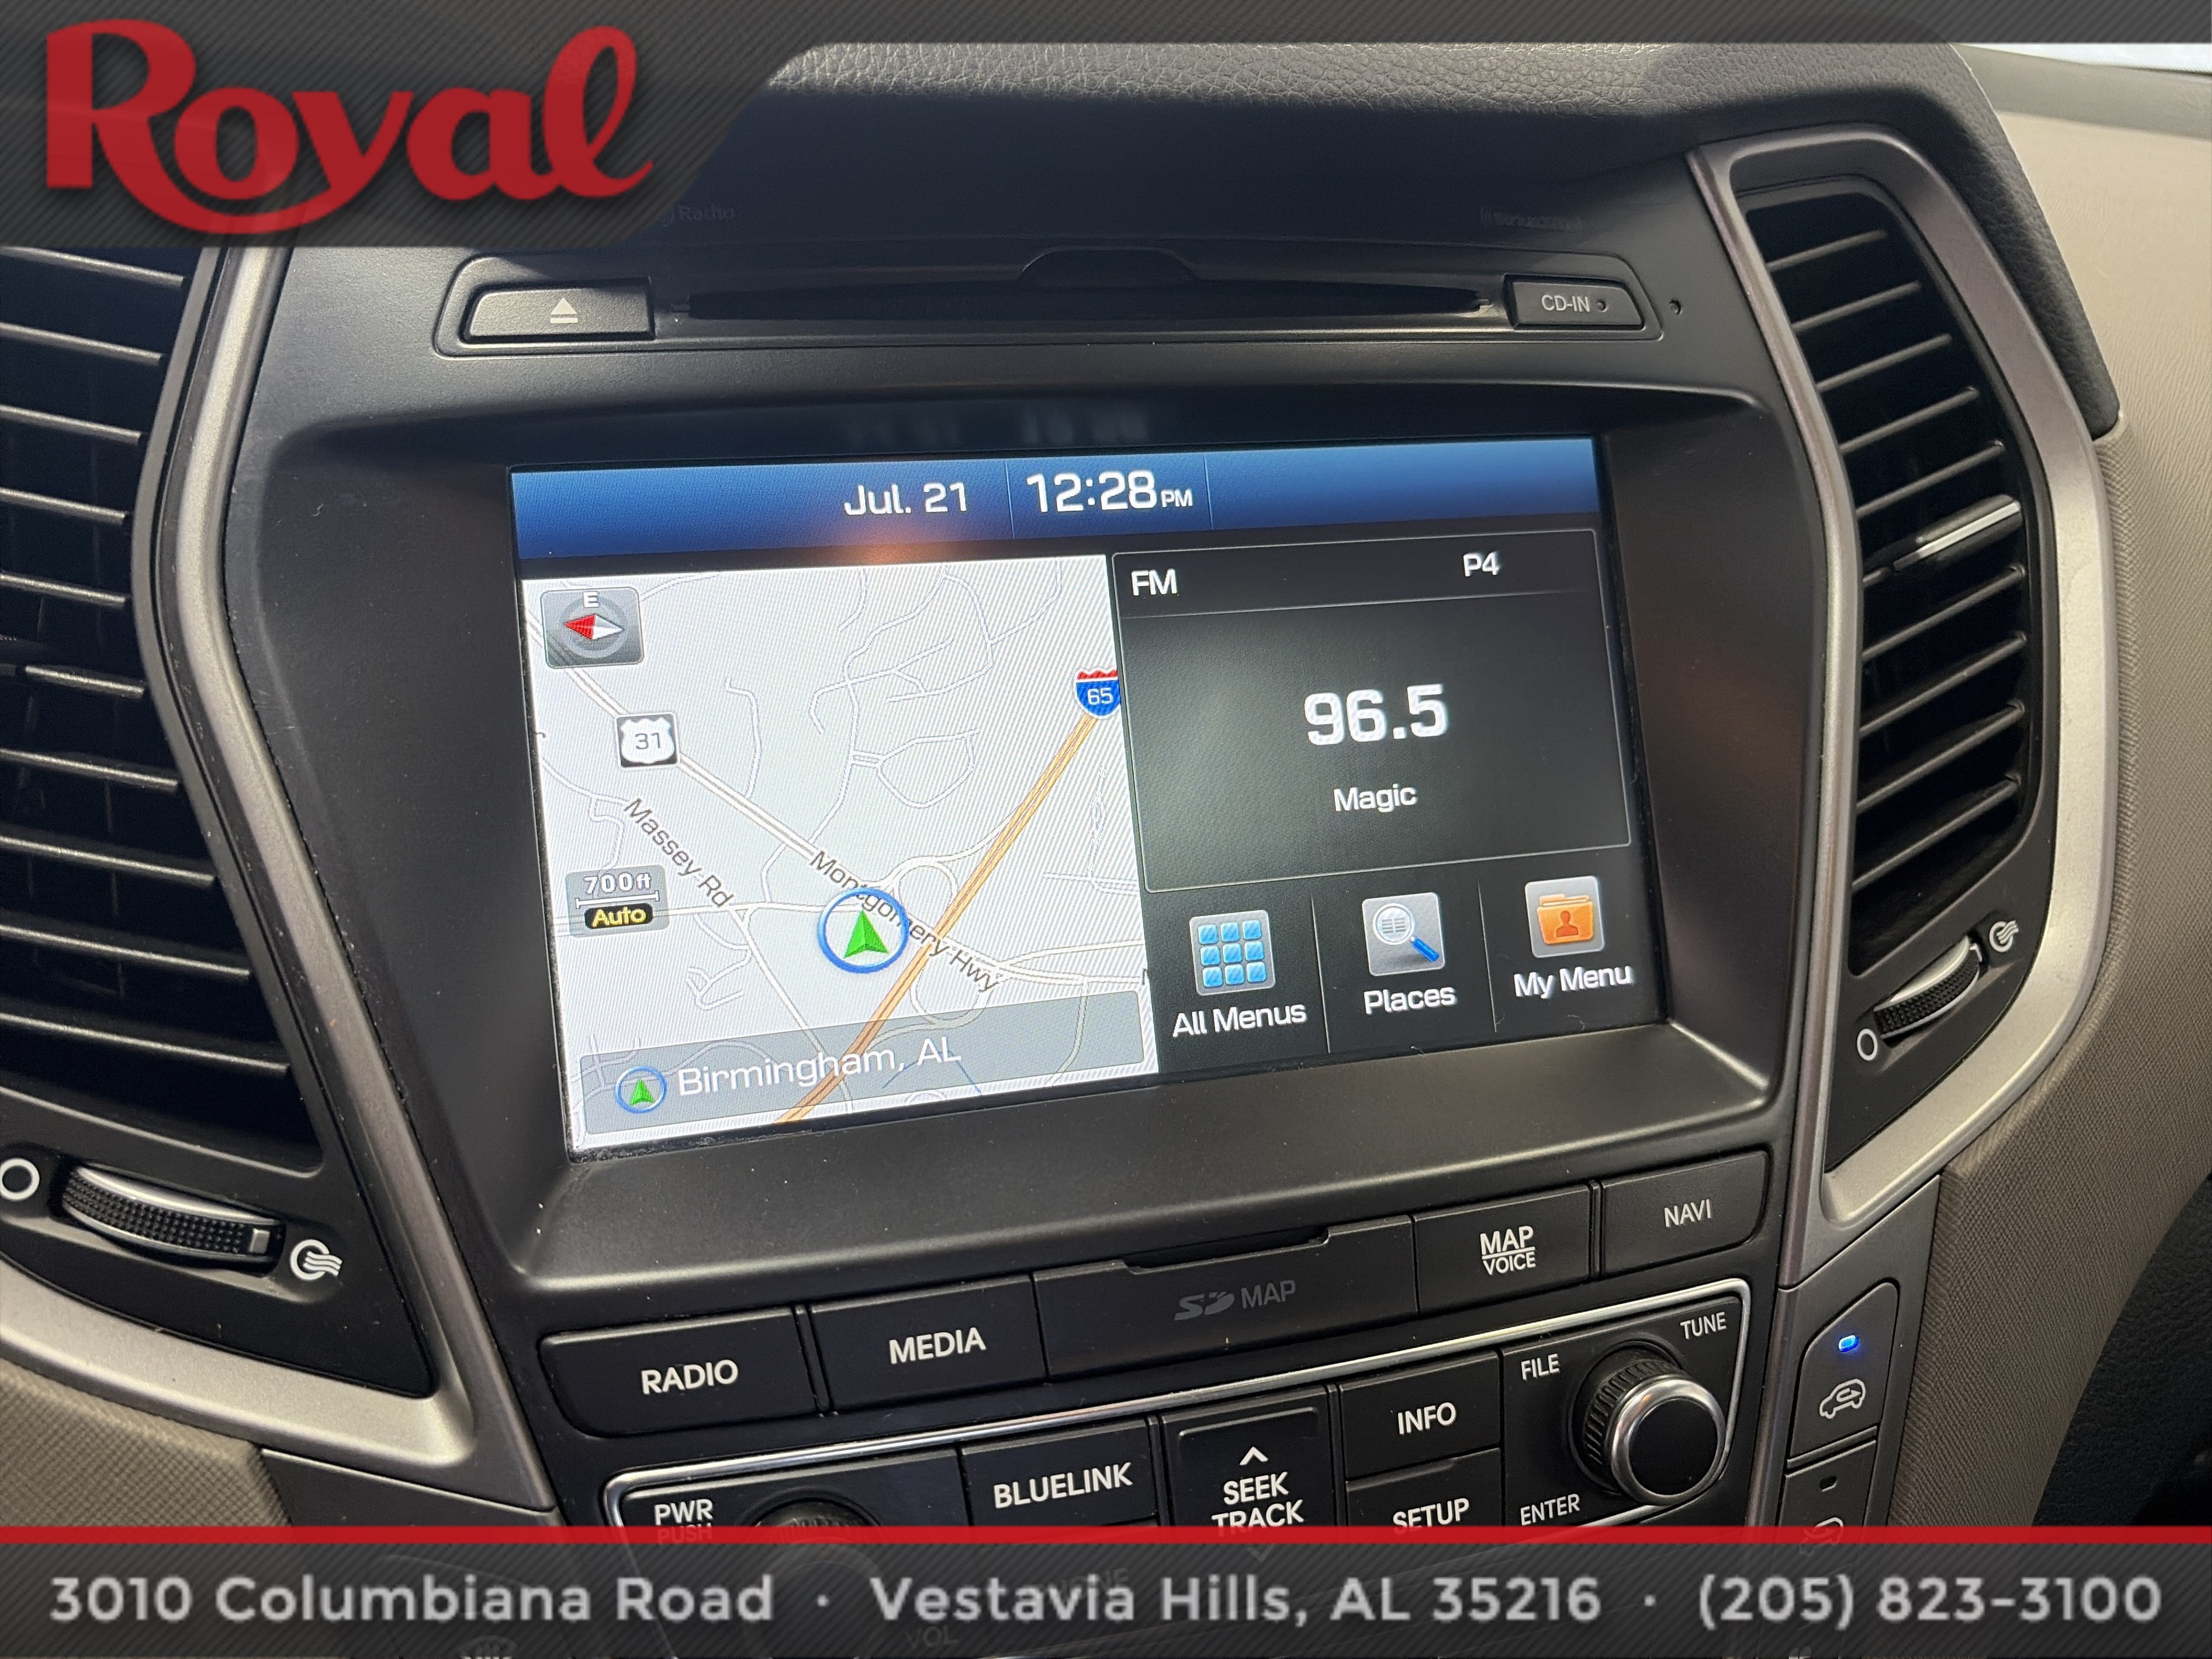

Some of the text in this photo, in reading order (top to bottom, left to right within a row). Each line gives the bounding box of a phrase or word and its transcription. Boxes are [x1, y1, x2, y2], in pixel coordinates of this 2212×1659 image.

[1541, 294, 1590, 313] CD-IN
[843, 482, 969, 516] Jul. 21
[1463, 551, 1501, 577] P4
[1131, 568, 1178, 597] FM
[583, 591, 600, 607] E
[1087, 686, 1114, 706] 65
[1304, 683, 1448, 746] 96.5
[635, 732, 663, 750] 31
[1333, 782, 1418, 812] Magic
[624, 798, 734, 908] Massey Rd
[583, 872, 653, 895] 700ft
[591, 903, 647, 927] Auto
[950, 949, 999, 992] Hwy
[1514, 964, 1633, 1000] My Menu
[1364, 985, 1457, 1015] Places
[1172, 1002, 1307, 1038] All Menus
[678, 1036, 962, 1097] Birmingham, AL
[1664, 1199, 1712, 1228] NAVI
[1480, 1226, 1534, 1256] MAP
[1482, 1250, 1536, 1276] VOICE
[1240, 1279, 1296, 1309] MAP
[1680, 1311, 1727, 1340] TUNE
[889, 1327, 986, 1364] MEDIA
[641, 1358, 738, 1395] RADIO
[1521, 1353, 1560, 1381] FILE
[1397, 1401, 1457, 1435] INFO
[993, 1462, 1133, 1509] BLUELINK
[1223, 1471, 1289, 1505] SEEK
[654, 1498, 713, 1526] PWR
[1211, 1499, 1305, 1538] TRACK
[1392, 1497, 1470, 1536] SETUP
[1520, 1493, 1581, 1526] ENTER
